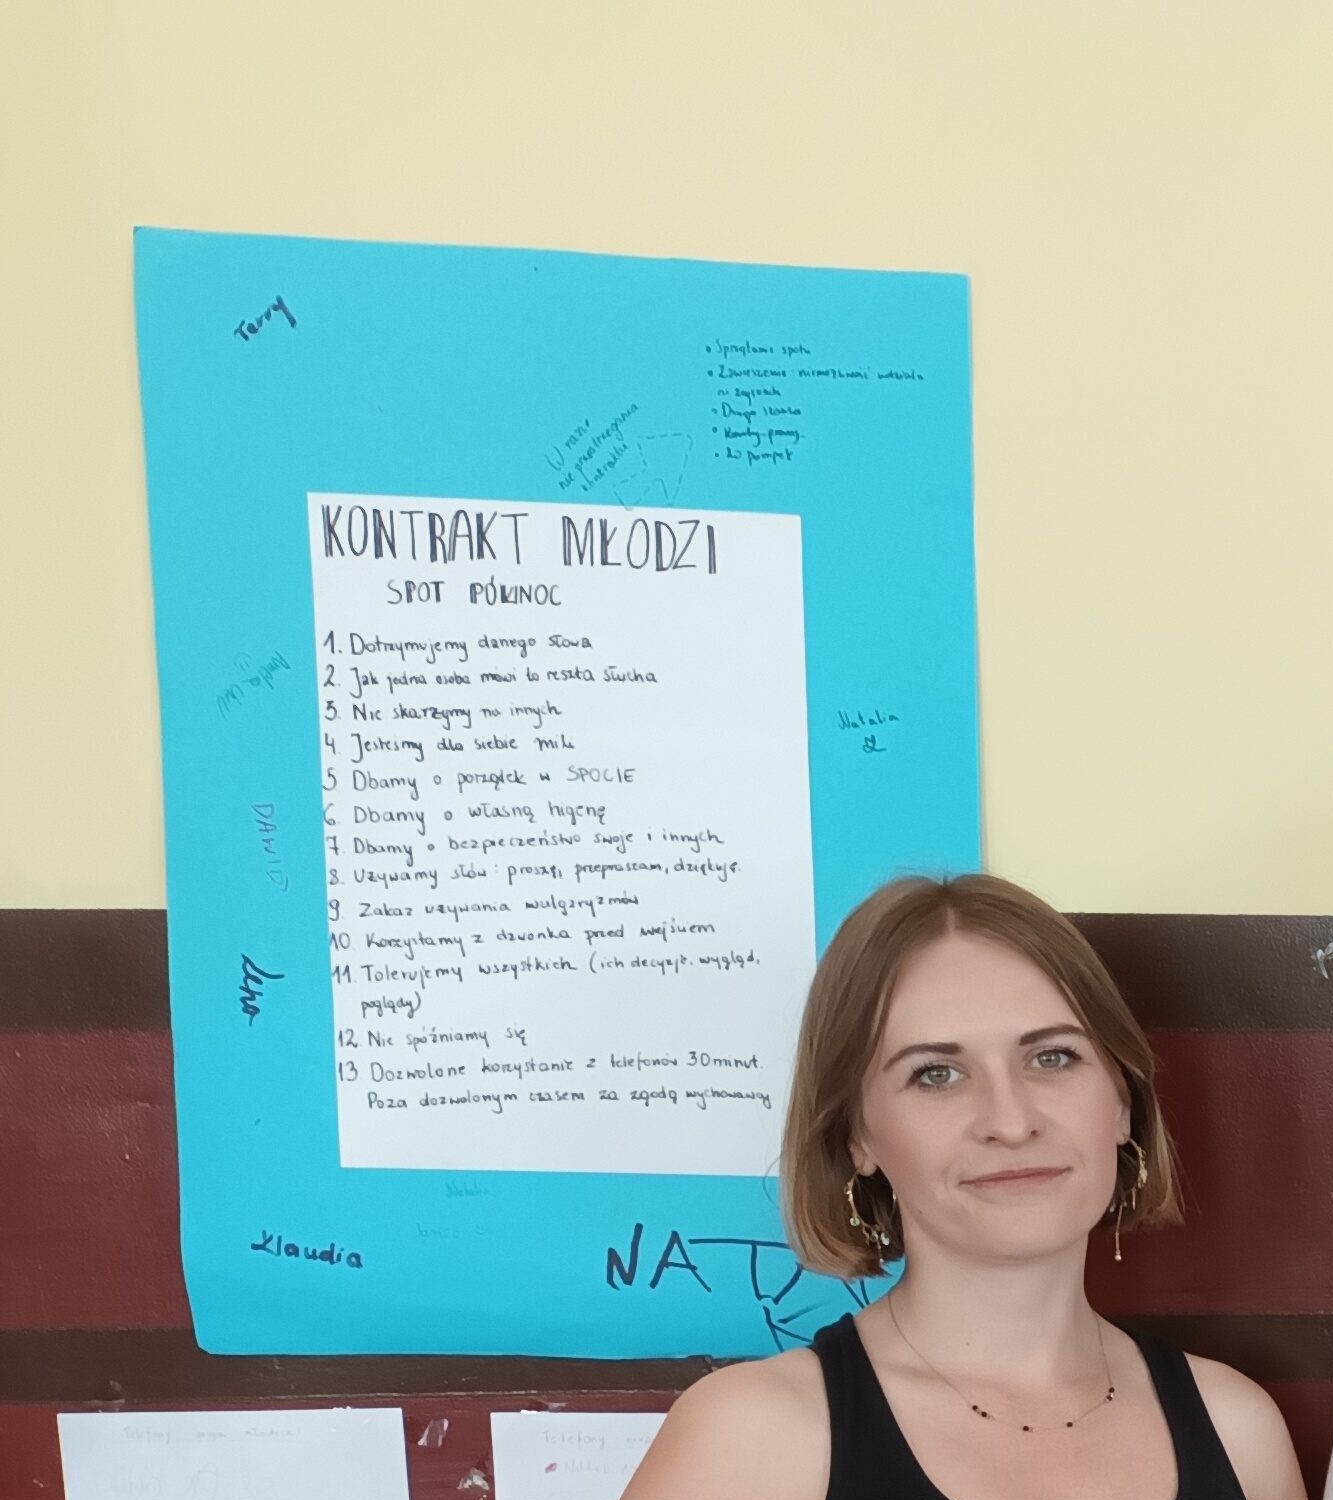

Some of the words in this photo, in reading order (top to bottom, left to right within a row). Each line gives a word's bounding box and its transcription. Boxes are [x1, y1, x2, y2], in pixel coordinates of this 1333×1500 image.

[321, 505, 529, 565] KONTRAKT
[562, 516, 717, 575] MŁODZI
[387, 579, 445, 605] SPOT
[470, 575, 561, 606] PÓŁNOC
[323, 630, 343, 654] 1.
[350, 632, 468, 664] Dotrzymujemy
[478, 634, 536, 658] danego
[548, 634, 592, 648] słowa
[323, 664, 341, 687] 2.
[349, 667, 379, 699] Jak
[386, 671, 428, 695] jedna
[436, 671, 471, 685] osoba
[526, 666, 539, 682] to
[547, 666, 595, 682] reszta
[603, 668, 658, 683] słucha
[324, 701, 341, 721] 3.
[352, 703, 382, 721] Nie
[480, 708, 502, 718] na
[510, 700, 562, 729] innych
[437, 737, 464, 751] dla
[474, 734, 518, 750] siebie
[534, 734, 575, 751] mili
[353, 769, 419, 801] Dbamy
[433, 775, 442, 785] o
[457, 769, 527, 794] porządek
[539, 772, 550, 781] w
[567, 765, 636, 783] SPOCIE
[354, 806, 426, 836] Dbamy
[444, 810, 453, 821] o
[468, 803, 536, 823] własną
[353, 837, 414, 867] Dbamy
[427, 843, 435, 851] o
[448, 829, 581, 855] bezpieczeństwo
[593, 833, 633, 854] swoje
[647, 833, 652, 841] i
[663, 829, 725, 853] innych
[359, 903, 413, 917] Zakaz
[366, 931, 466, 961] Korzystamy
[472, 934, 484, 943] z
[496, 927, 572, 941] dzwonka
[584, 924, 624, 946] przed
[360, 964, 463, 990] Tolerujemy
[479, 956, 578, 980] wszystkich
[589, 951, 624, 974] (ich
[361, 991, 421, 1019] poglądy)
[368, 1030, 394, 1047] Nie
[406, 1026, 489, 1053] spóźniamy
[506, 1027, 527, 1046] się
[370, 1062, 465, 1082] Dozwolone
[482, 1058, 573, 1080] korzystanie
[586, 1058, 596, 1068] z
[367, 1092, 408, 1109] Poza
[419, 1090, 517, 1114] dozwolonym
[529, 1091, 585, 1102] czasem
[599, 1090, 619, 1101] za
[630, 1086, 677, 1107] zgodą
[542, 1431, 605, 1450] Telefony
